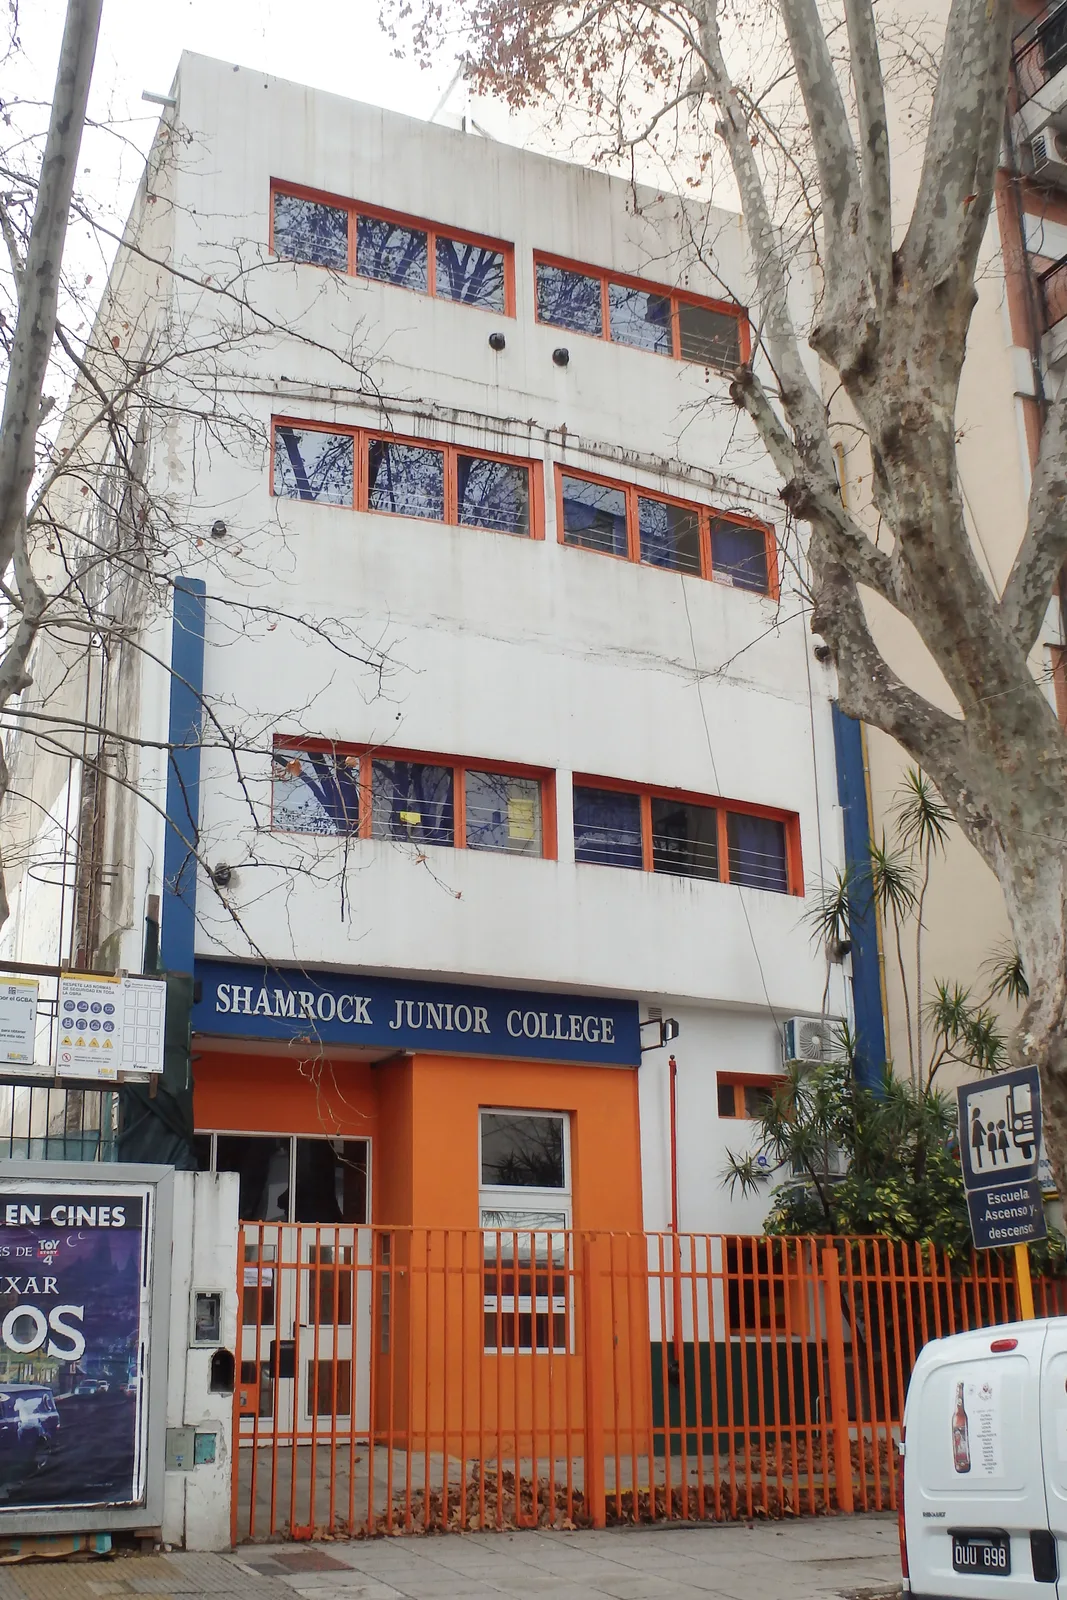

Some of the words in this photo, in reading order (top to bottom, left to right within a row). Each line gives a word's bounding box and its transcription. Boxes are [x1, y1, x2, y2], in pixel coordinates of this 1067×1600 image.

[215, 983, 373, 1026] SHAMROCK
[389, 999, 491, 1034] JUNIOR
[506, 1010, 616, 1044] COLLEGE
[987, 1188, 1029, 1205] Escuela
[5, 1204, 41, 1227] EN
[50, 1205, 126, 1227] CINES
[985, 1205, 1028, 1221] Ascenso
[1029, 1203, 1035, 1217] y
[989, 1223, 1033, 1239] descenso
[16, 1246, 32, 1257] DE
[38, 1239, 60, 1250] TOY
[43, 1256, 53, 1265] 4
[2, 1304, 86, 1361] OS
[955, 1545, 977, 1565] OUU
[983, 1547, 1006, 1567] 898
